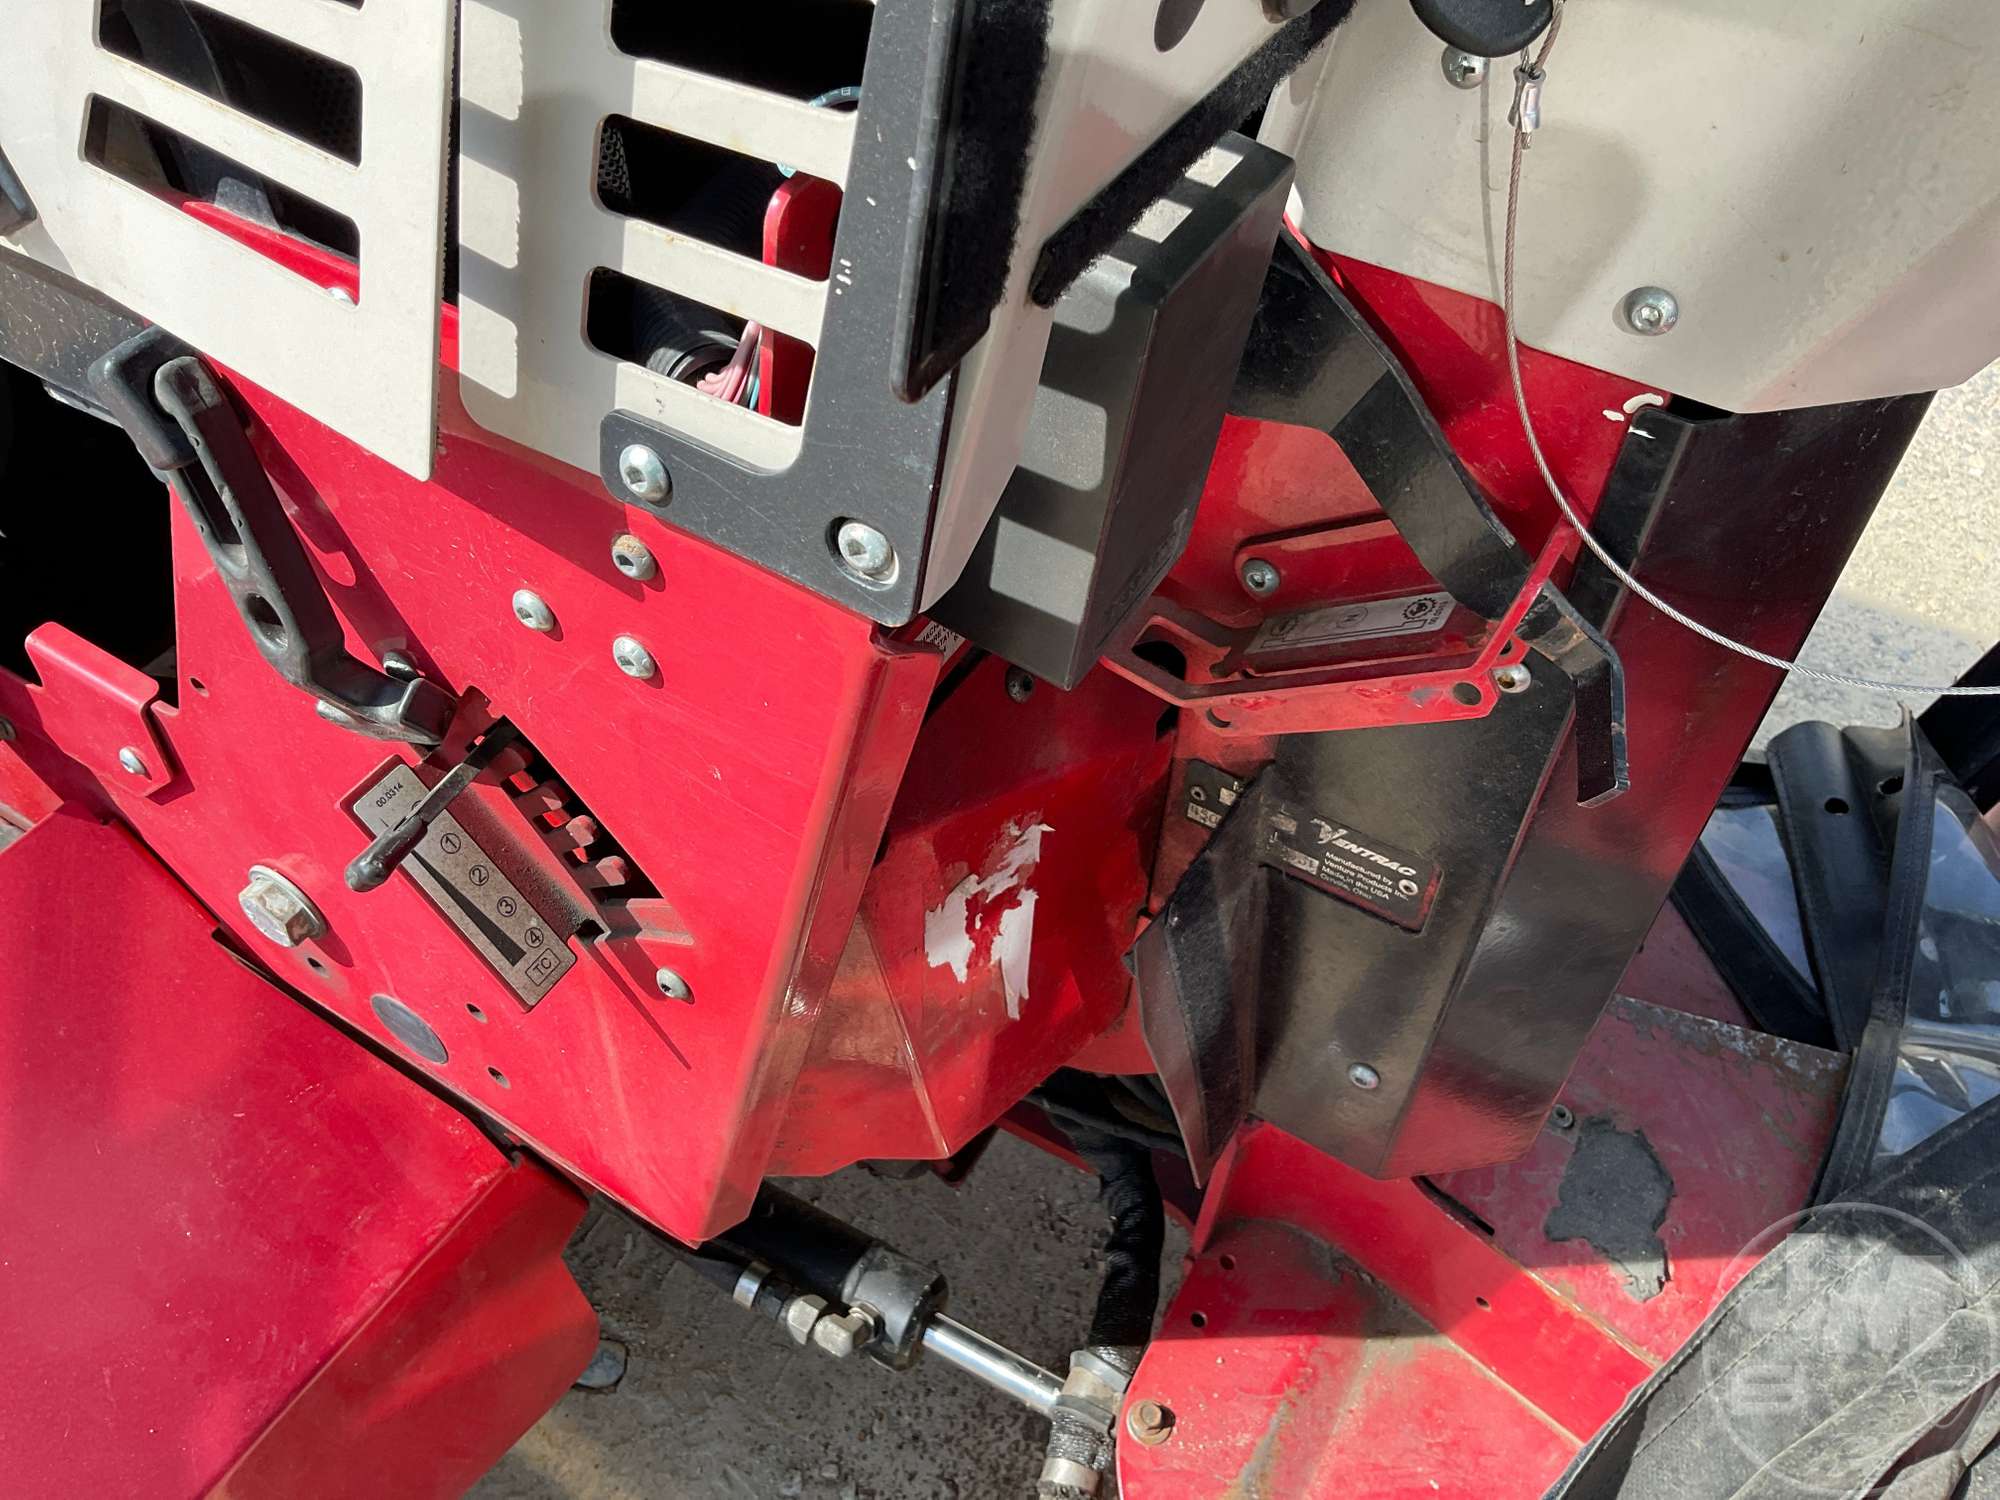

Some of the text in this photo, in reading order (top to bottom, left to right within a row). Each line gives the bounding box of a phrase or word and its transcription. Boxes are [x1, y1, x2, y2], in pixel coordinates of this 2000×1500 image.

[1309, 817, 1417, 877] VENTRAC
[1321, 866, 1345, 880] Made
[1355, 881, 1369, 892] the
[1370, 887, 1390, 901] USA
[1324, 858, 1355, 877] Venture
[1357, 873, 1393, 894] Products
[1325, 851, 1382, 880] Manufactured
[1382, 876, 1393, 886] by
[532, 956, 552, 976] TC
